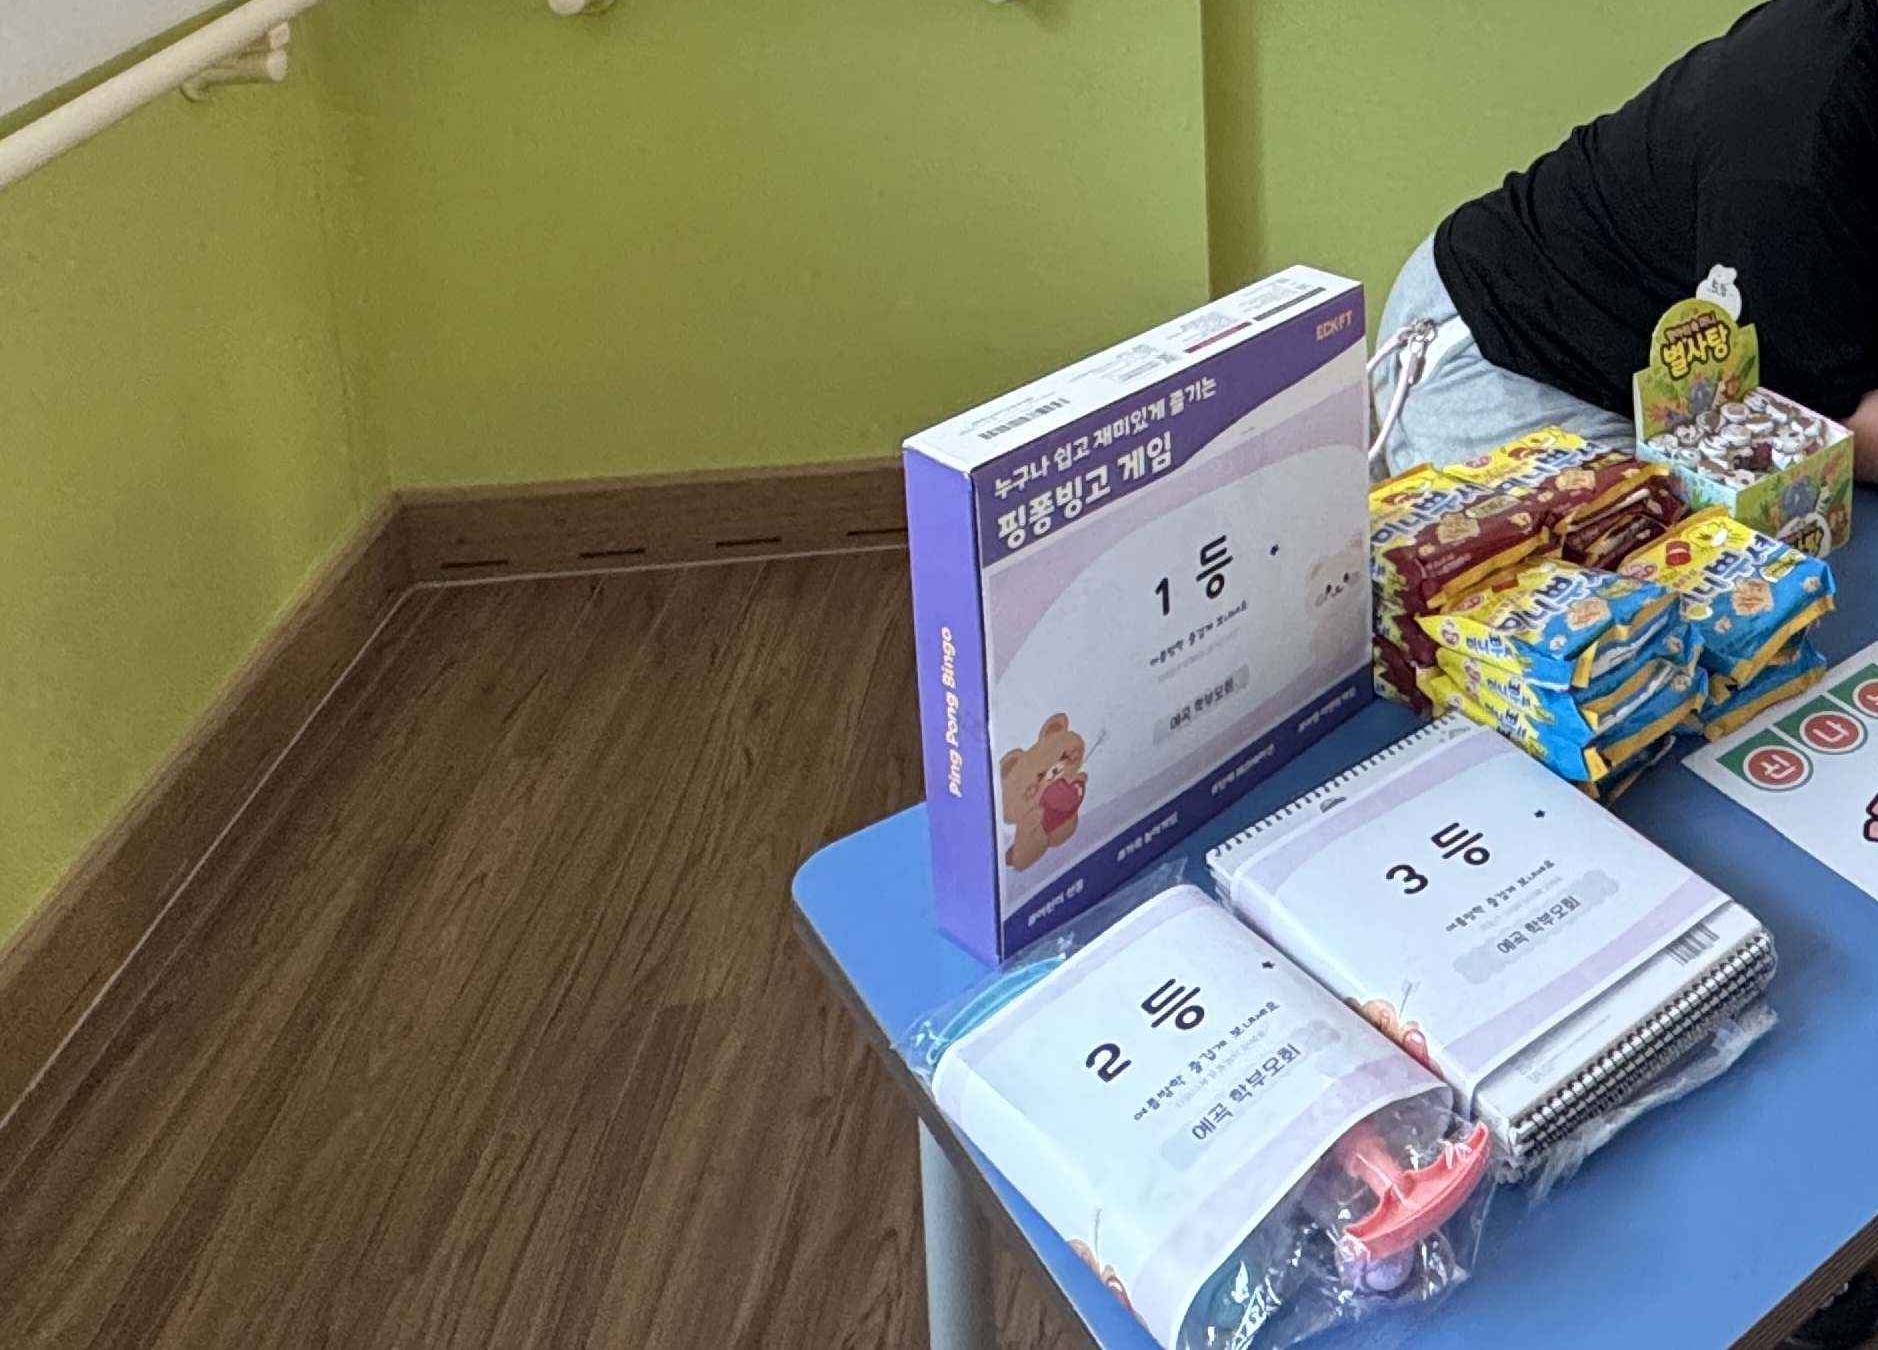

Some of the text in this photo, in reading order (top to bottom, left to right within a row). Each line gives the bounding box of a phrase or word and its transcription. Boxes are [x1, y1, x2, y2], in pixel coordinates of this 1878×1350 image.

[1660, 322, 1731, 380] 별사탕
[993, 458, 1051, 501] 누구나
[1053, 442, 1090, 477] 쉽고
[1093, 403, 1166, 458] 재미있게
[1168, 375, 1218, 419] 즐기는
[996, 431, 1173, 550] 핑퐁빙고 게임
[940, 626, 963, 799] Ping Pong Bingo
[1495, 924, 1529, 956] 예곡
[1527, 893, 1583, 939] 학부모회
[1190, 1100, 1234, 1142] 예곡
[1228, 1041, 1303, 1106] 학부모회
